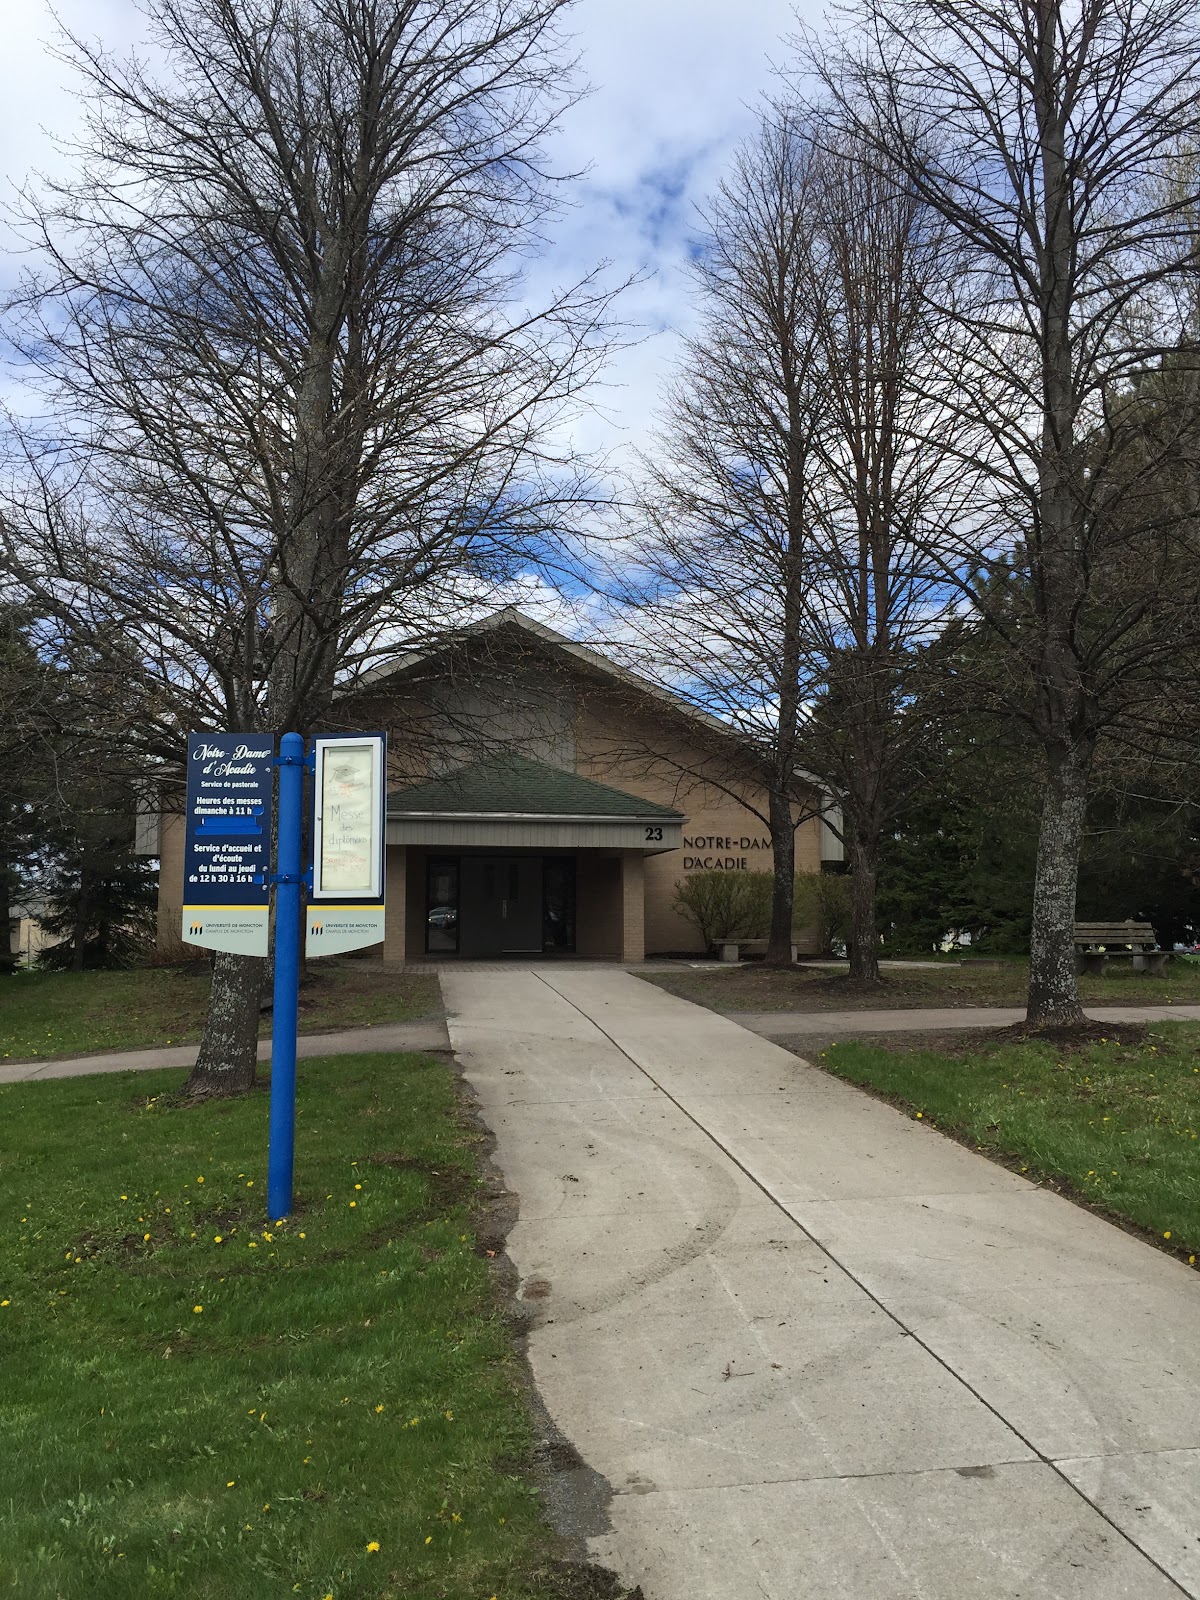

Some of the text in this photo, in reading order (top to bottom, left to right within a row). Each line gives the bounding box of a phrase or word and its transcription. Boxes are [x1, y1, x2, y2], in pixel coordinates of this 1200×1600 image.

[203, 760, 256, 776] d'Acadie
[196, 796, 223, 804] Heures
[223, 796, 235, 804] des
[229, 806, 234, 814] à
[330, 804, 364, 821] Messe
[645, 828, 662, 840] 23
[194, 844, 262, 852] Service d'accueil et
[683, 836, 773, 849] NOTRE-DAM
[212, 854, 243, 862] d'écoute
[683, 857, 747, 870] D'ACADIE
[238, 864, 256, 874] jeudi
